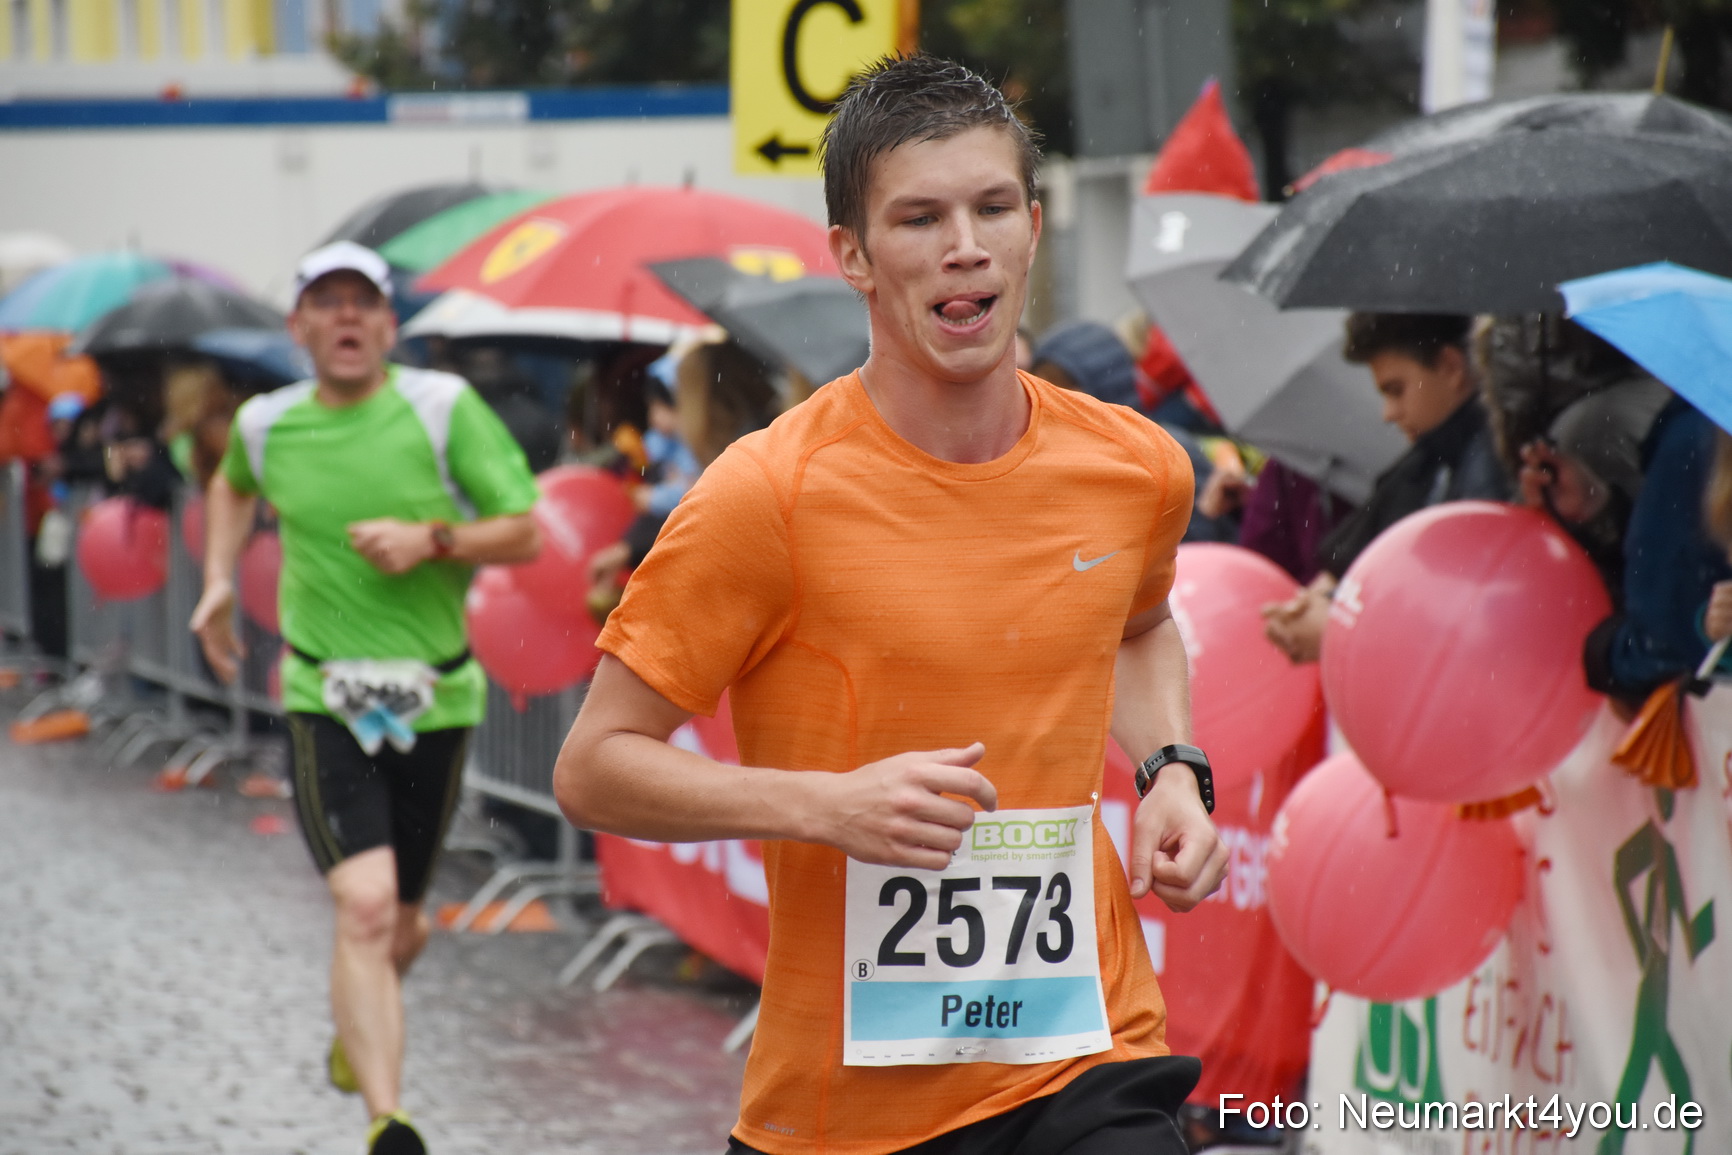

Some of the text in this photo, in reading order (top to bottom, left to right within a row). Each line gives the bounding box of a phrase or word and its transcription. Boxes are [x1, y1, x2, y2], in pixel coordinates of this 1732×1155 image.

[782, 0, 864, 114] C
[972, 818, 1078, 850] BOCK
[970, 851, 1009, 862] inspired
[1011, 851, 1023, 862] by
[1026, 851, 1052, 860] smart
[877, 871, 1075, 968] 2573
[858, 962, 868, 978] B
[940, 994, 1023, 1029] Peter
